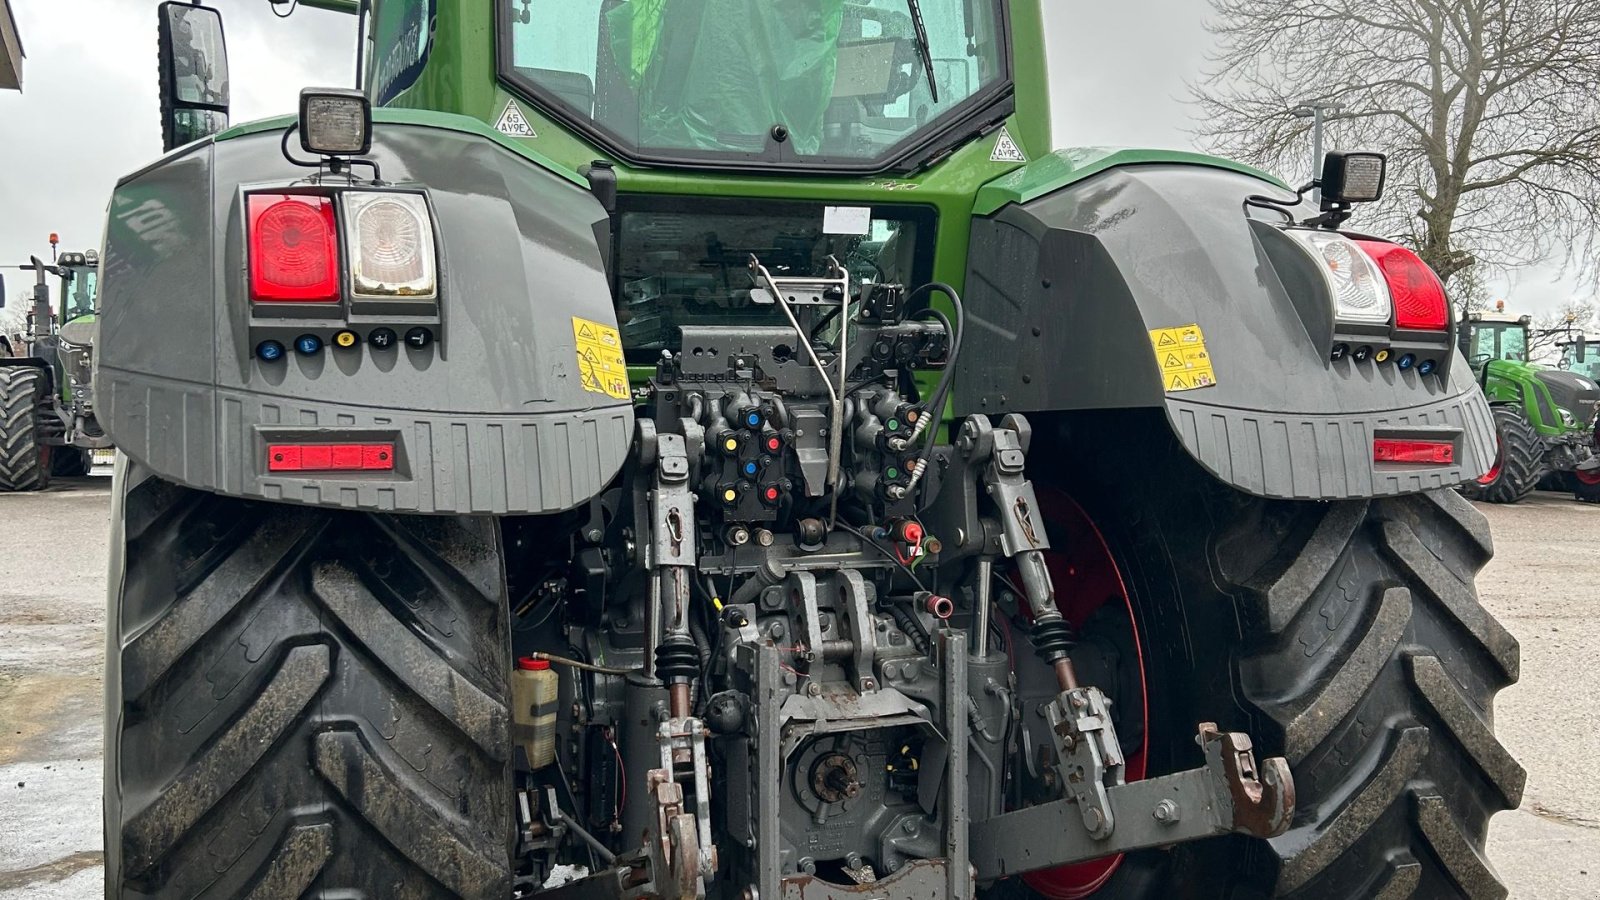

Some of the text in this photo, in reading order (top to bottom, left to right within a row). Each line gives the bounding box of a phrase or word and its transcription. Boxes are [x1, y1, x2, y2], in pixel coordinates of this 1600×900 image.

[506, 113, 519, 123] 65
[501, 123, 525, 133] AY9E
[1001, 140, 1012, 149] 65
[998, 149, 1018, 158] AY9E
